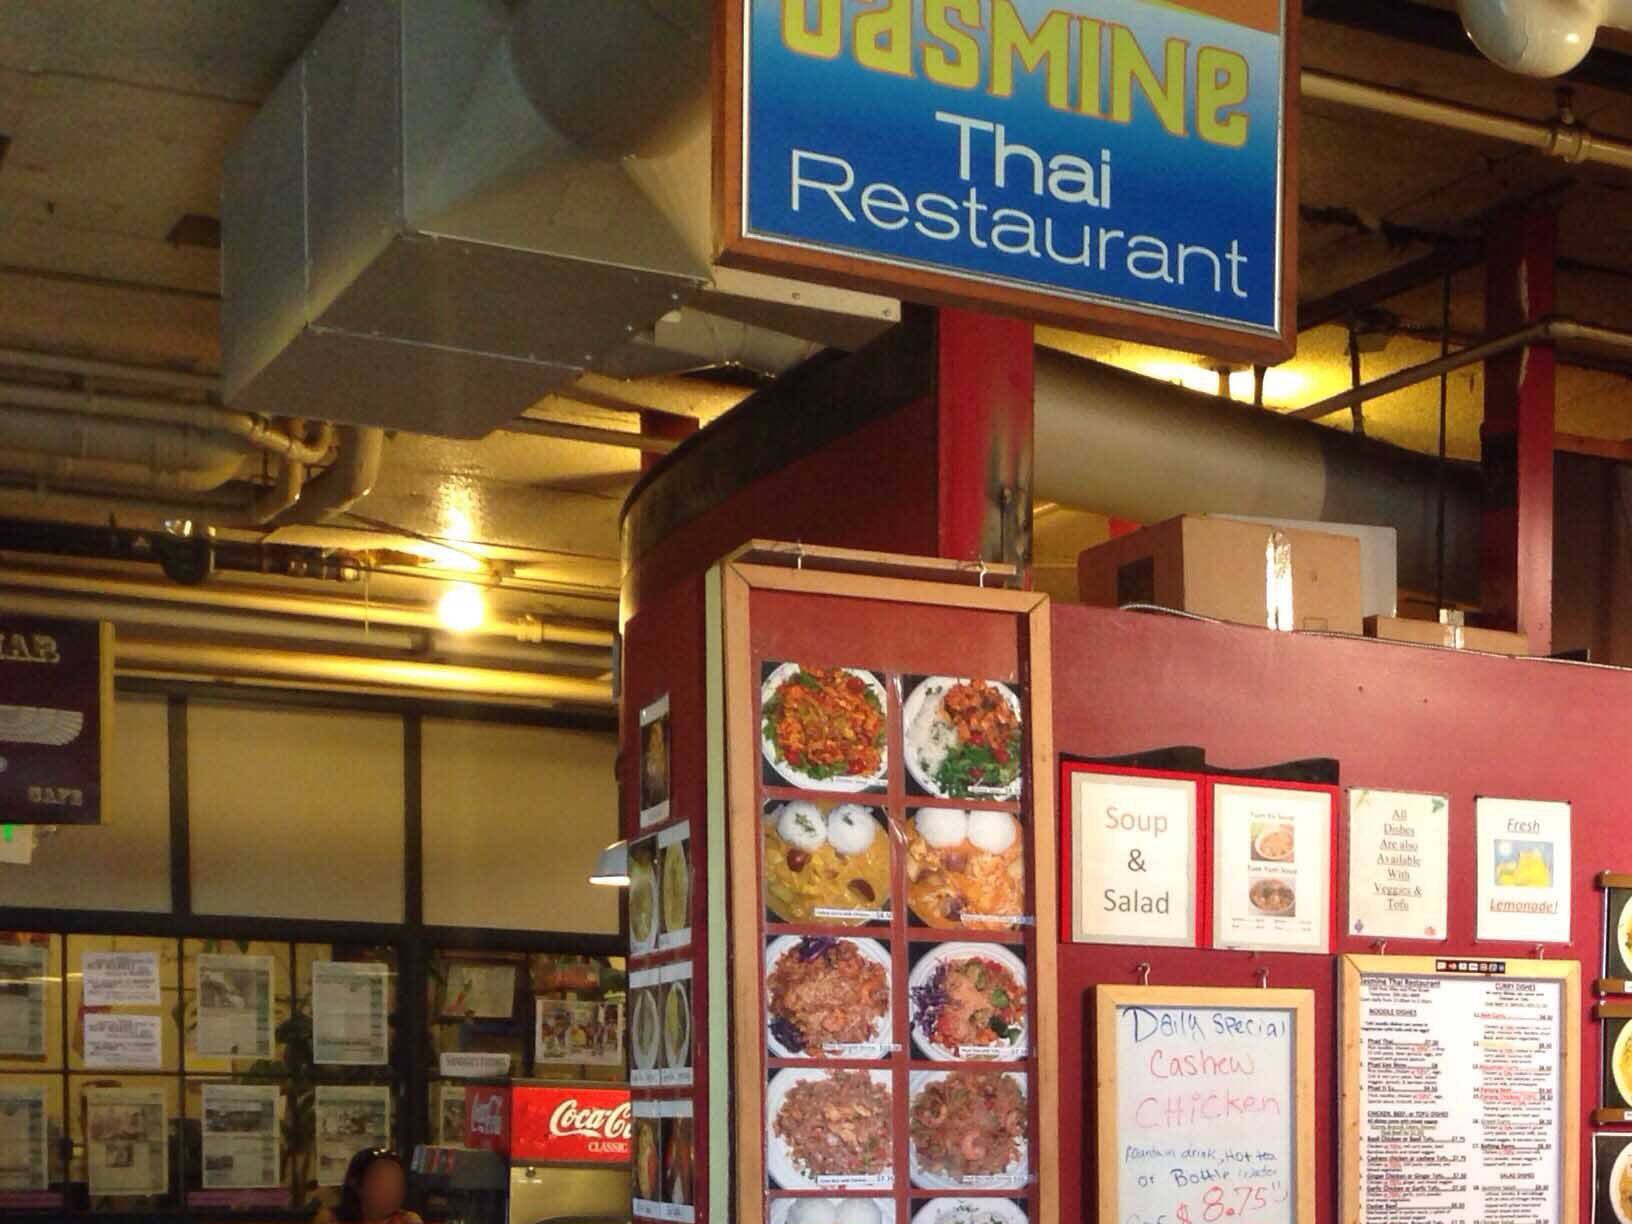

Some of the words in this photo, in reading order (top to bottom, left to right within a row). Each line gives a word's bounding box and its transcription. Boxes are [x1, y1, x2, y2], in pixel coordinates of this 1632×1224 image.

[934, 110, 1112, 208] Thai
[791, 149, 1248, 298] Restaurant
[1105, 805, 1169, 835] Soup
[1391, 809, 1408, 821] All
[1383, 823, 1415, 837] Dishes
[1507, 818, 1540, 834] Fresh
[1380, 839, 1398, 851] Are
[1127, 848, 1146, 872] &
[1377, 853, 1421, 868] Available
[1387, 869, 1410, 881] With
[1374, 882, 1411, 897] Veggies
[1103, 888, 1170, 915] Salad
[1387, 899, 1409, 911] Tofu
[1489, 899, 1559, 914] Lemonade!
[1123, 1006, 1206, 1043] Daily
[1149, 1049, 1255, 1079] Cashew
[549, 1098, 631, 1140] Coca-C
[588, 1142, 627, 1153] CLASSIC
